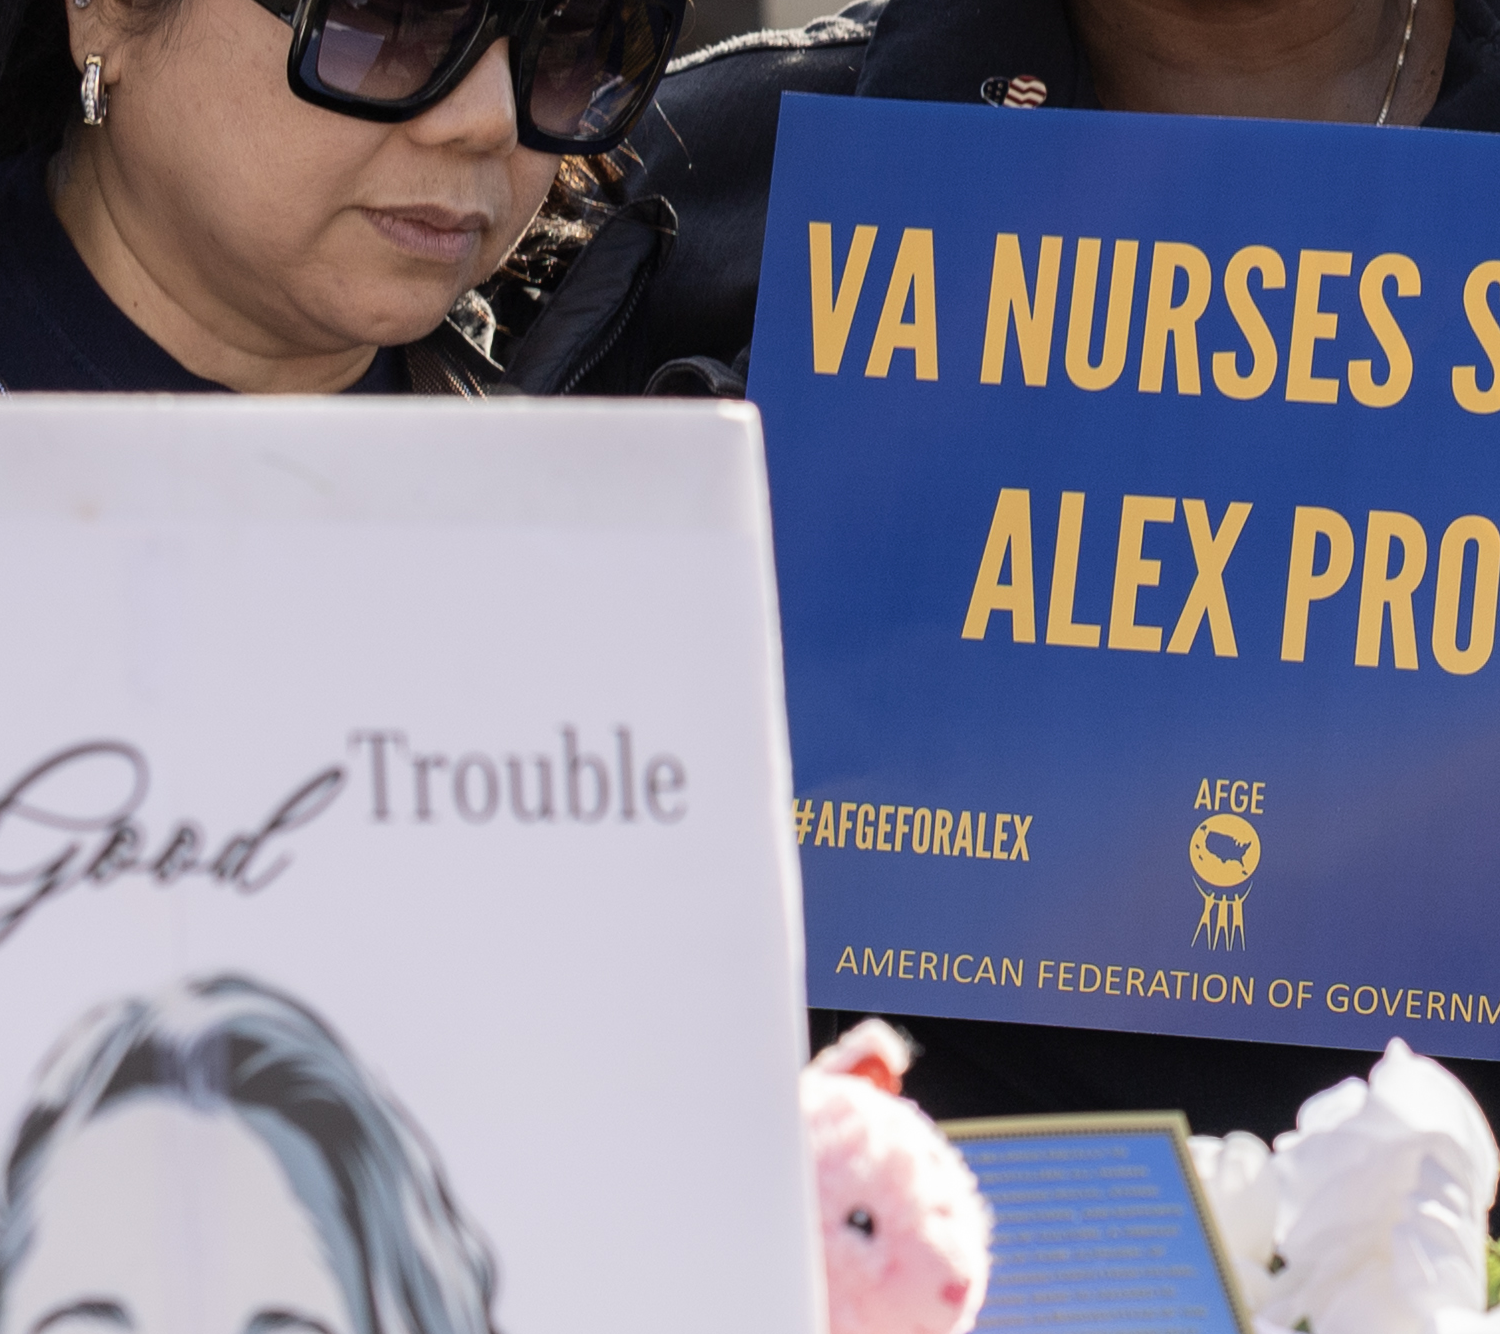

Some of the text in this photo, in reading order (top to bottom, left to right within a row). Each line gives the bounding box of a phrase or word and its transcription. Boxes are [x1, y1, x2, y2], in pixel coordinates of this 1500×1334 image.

[808, 221, 939, 381] VA
[979, 232, 1422, 408] NURSES
[961, 488, 1253, 658] ALEX
[348, 721, 690, 827] Trouble
[1194, 778, 1265, 815] AFGE
[792, 797, 1033, 862] #AFGEFORALEX
[835, 946, 1024, 988] AMERICAN
[1037, 960, 1255, 1006] FEDERATION
[1267, 979, 1313, 1010] OF
